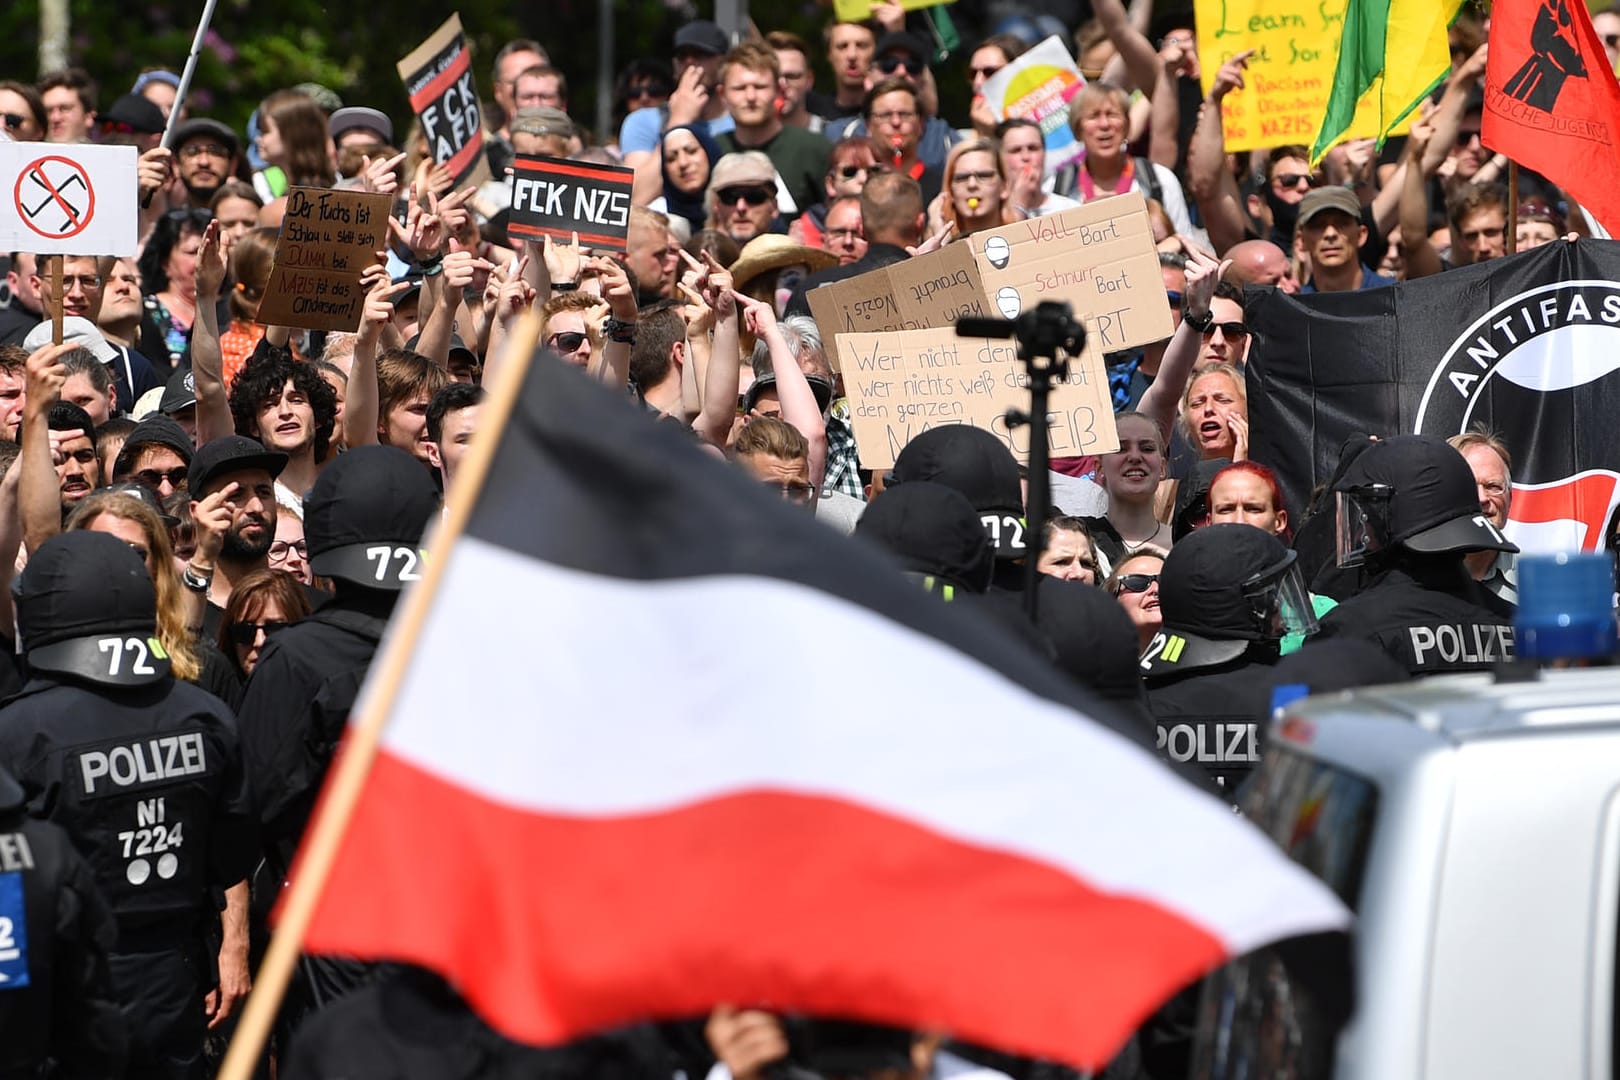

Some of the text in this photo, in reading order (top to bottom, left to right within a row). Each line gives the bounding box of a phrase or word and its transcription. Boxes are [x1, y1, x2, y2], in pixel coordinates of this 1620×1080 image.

[1215, 0, 1306, 38] Learn
[1288, 38, 1320, 65] for
[1254, 74, 1322, 95] Racism
[421, 71, 475, 140] FCK
[436, 103, 480, 167] AFD
[1226, 114, 1313, 140] No NAZIS
[288, 191, 371, 225] Der Fuchs ist
[514, 178, 630, 227] FCK NZS
[358, 233, 375, 248] sich
[1026, 213, 1120, 246] Voll Bart
[333, 252, 349, 269] bei
[278, 272, 351, 297] NAZIS ist das
[910, 269, 975, 305] braucht
[1035, 266, 1132, 294] Schnurr Bart
[850, 340, 904, 371] Wer
[919, 344, 961, 369] nicht
[858, 380, 895, 398] wer
[904, 374, 954, 398] nichts
[960, 370, 996, 399] weiß
[856, 401, 964, 422] den ganzen
[980, 515, 1027, 548] 72
[367, 546, 424, 582] 72
[98, 637, 155, 676] 72
[1139, 632, 1167, 670] 2
[1408, 623, 1516, 665] POLIZE
[1156, 723, 1261, 762] OLIZE
[79, 733, 207, 794] POLIZEI
[137, 797, 165, 827] NI
[118, 822, 183, 858] 7224
